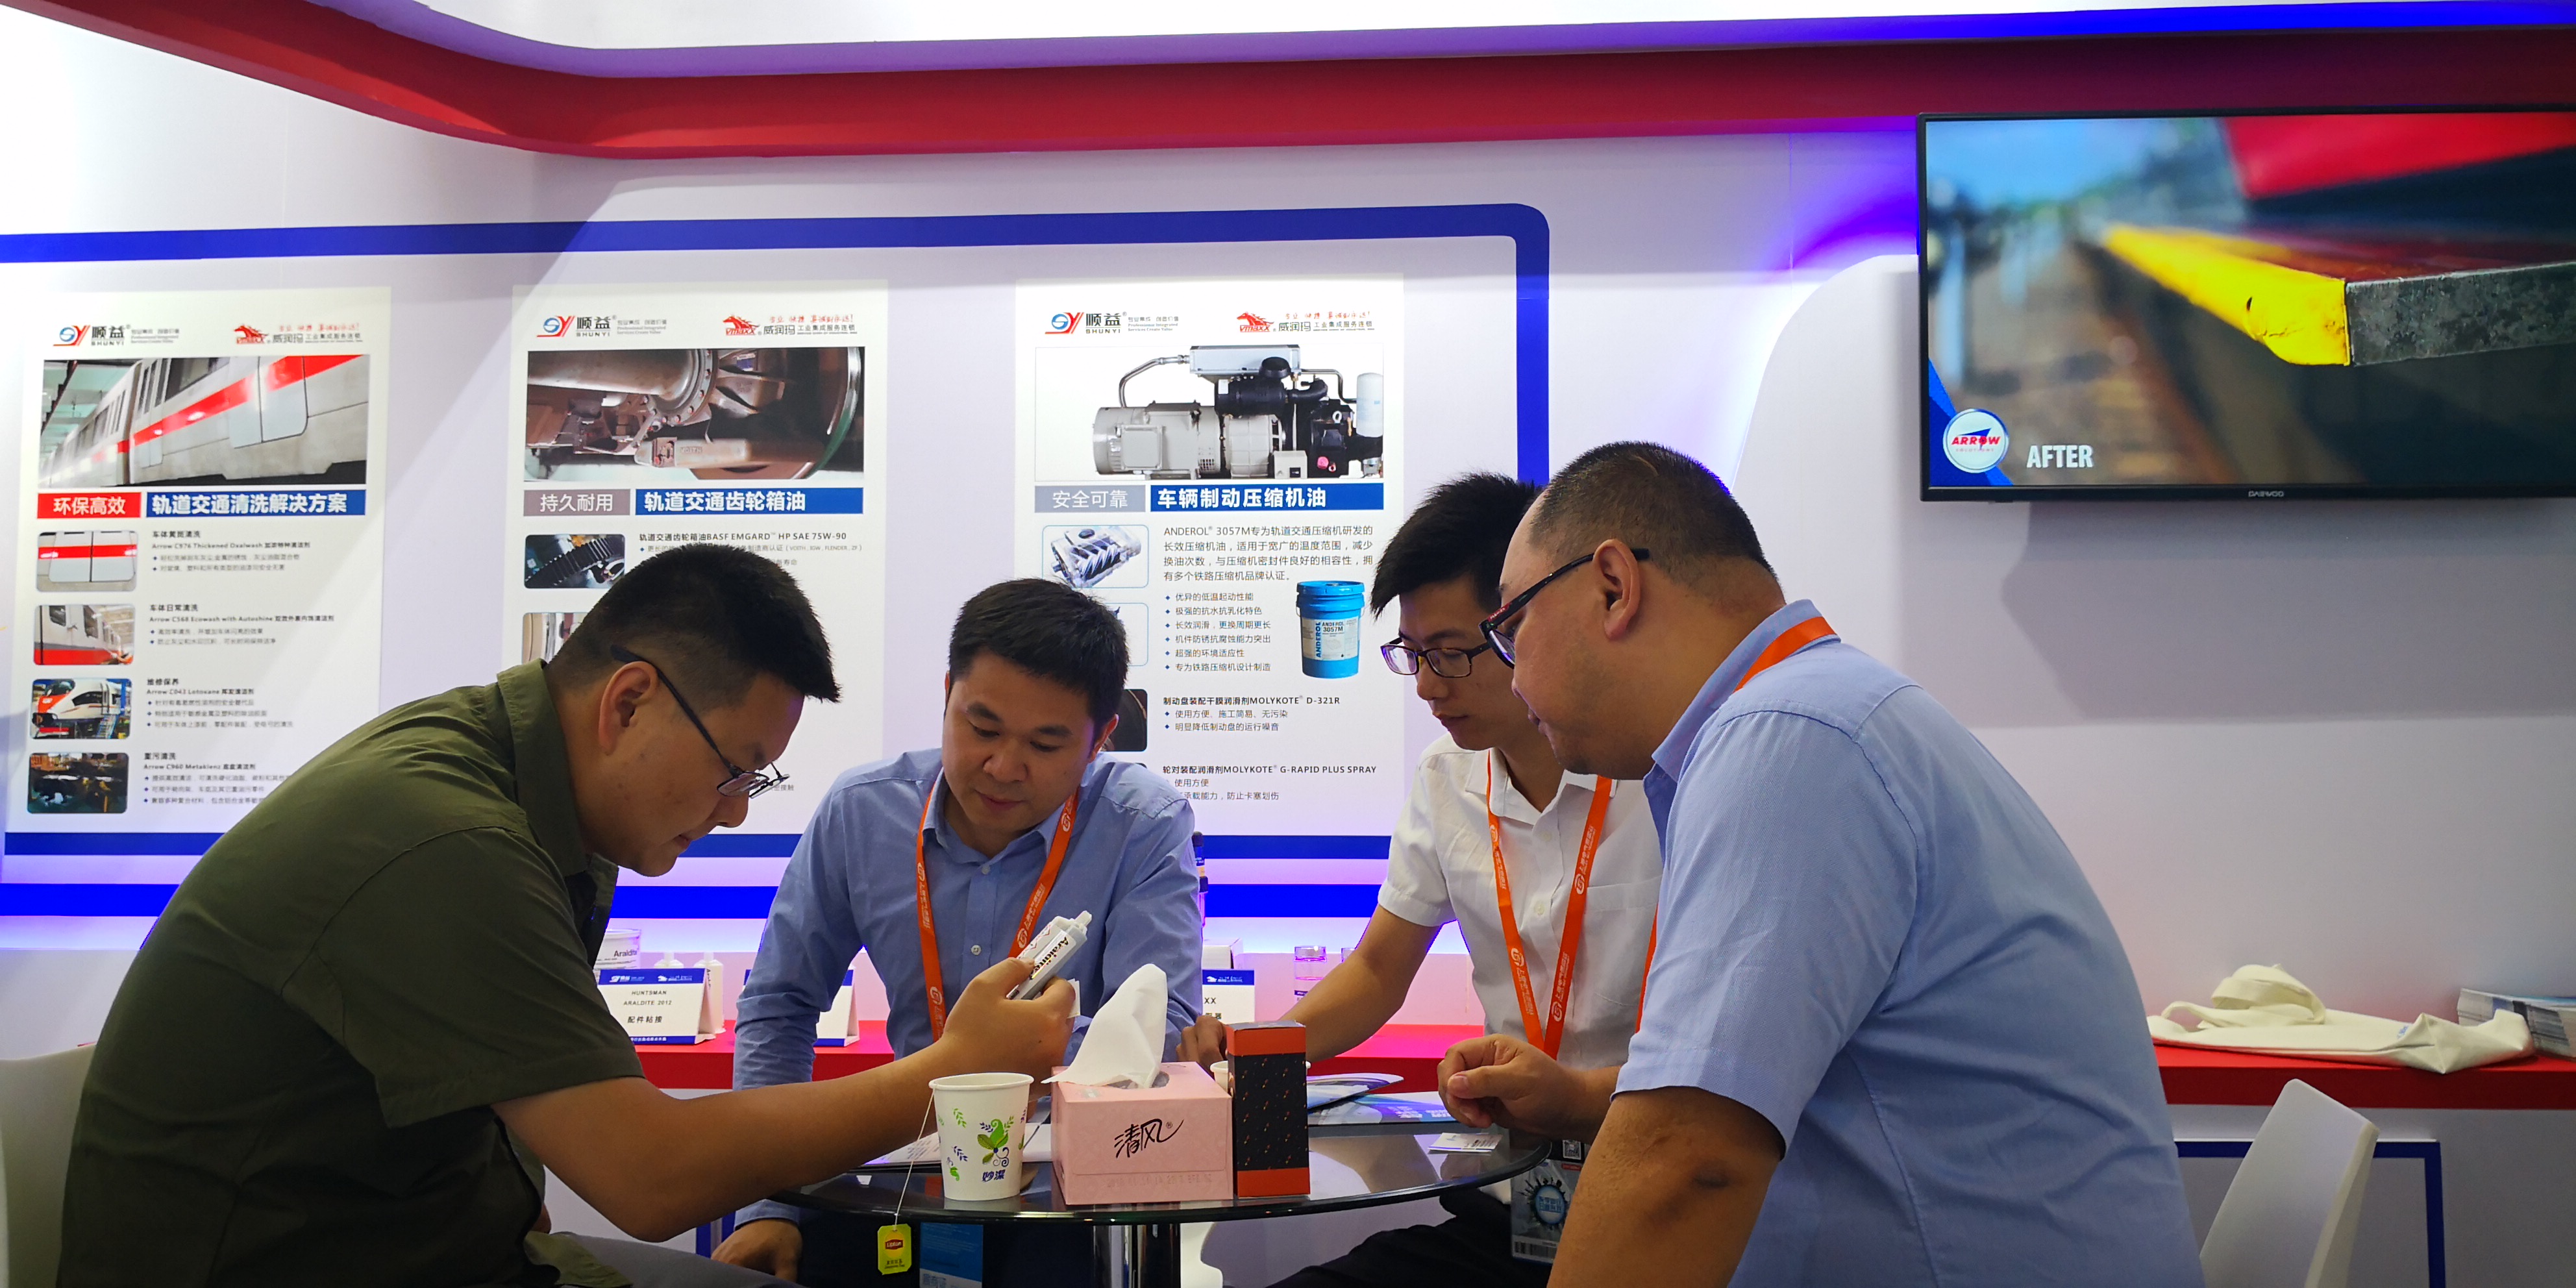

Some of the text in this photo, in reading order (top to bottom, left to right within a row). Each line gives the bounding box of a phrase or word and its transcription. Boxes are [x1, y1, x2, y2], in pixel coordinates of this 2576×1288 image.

[577, 316, 610, 329] 顺益
[1086, 313, 1121, 327] 顺益
[763, 325, 795, 335] 威润玛
[1278, 322, 1311, 332] 威润玛
[1951, 436, 2001, 445] ARROW
[2027, 445, 2094, 468] AFTER
[152, 493, 347, 514] 轨道交通清洗解决方案
[540, 495, 613, 512] 持久耐用
[644, 491, 806, 512] 轨道交通齿轮箱油
[1053, 490, 1128, 509] 安全可靠
[1157, 488, 1327, 508] 车辆制动压缩机油
[53, 497, 126, 515] 环保高效
[1176, 593, 1254, 602] 优异的低温起动性能
[1176, 635, 1270, 643] 机件防锈抗腐蚀能力突出
[1176, 649, 1245, 658] 超强的环境适应性
[1176, 663, 1270, 672] 专为铁路压缩机设计制造
[1176, 723, 1279, 732] 明显降低制动盘的运行噪音
